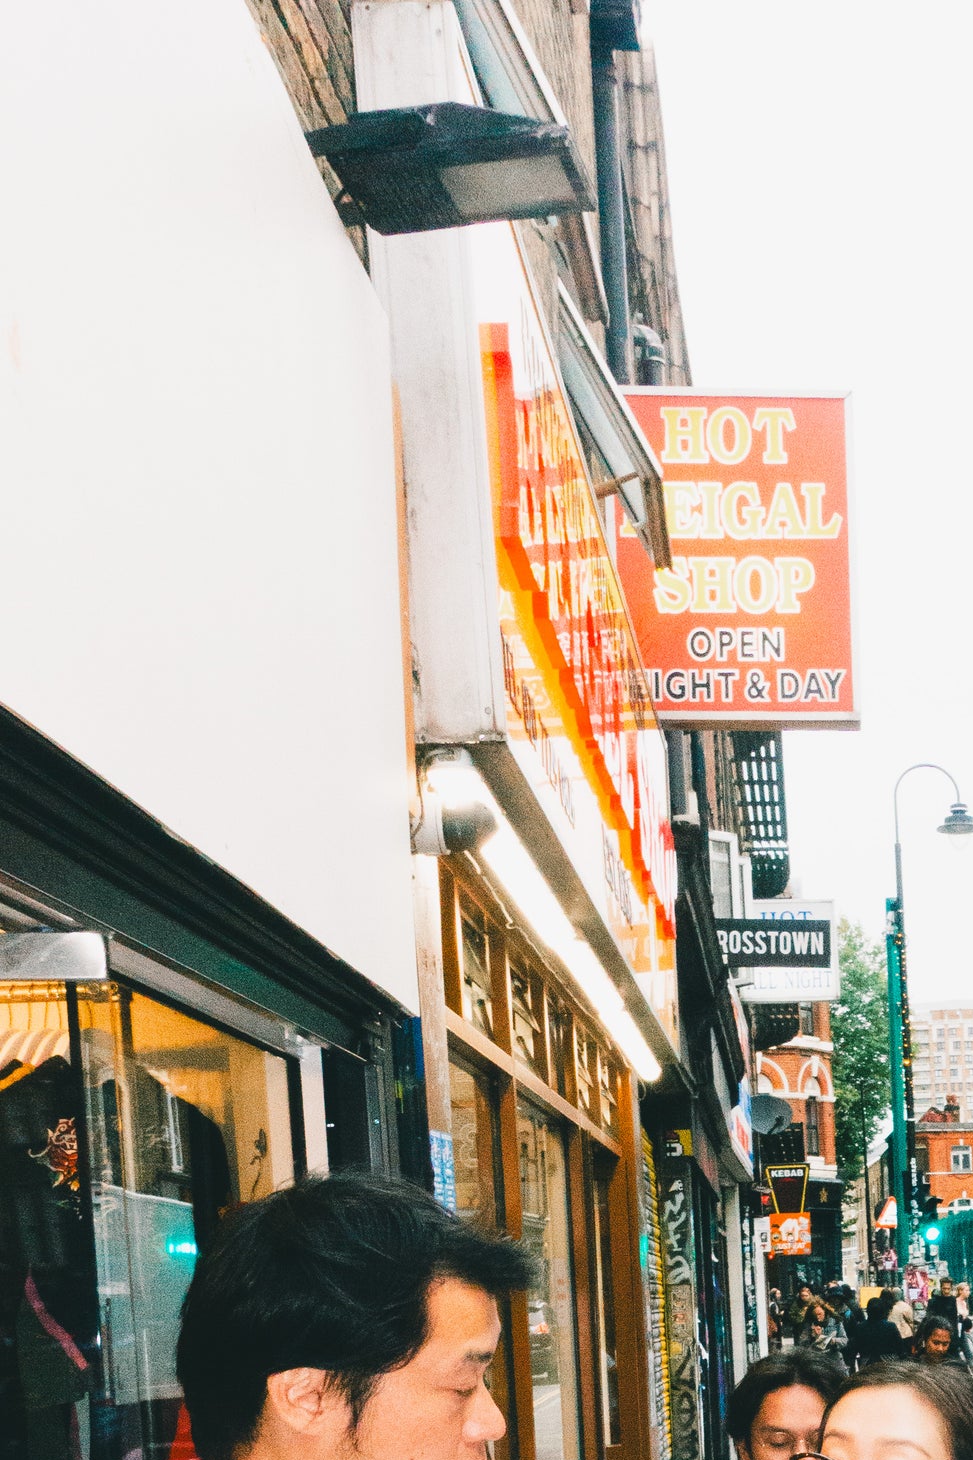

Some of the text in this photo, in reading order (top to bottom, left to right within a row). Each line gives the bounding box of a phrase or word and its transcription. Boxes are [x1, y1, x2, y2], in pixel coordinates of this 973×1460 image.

[660, 406, 797, 465] HOT
[620, 481, 843, 539] EIGAL
[652, 556, 816, 614] SHOP
[688, 628, 784, 661] OPEN
[645, 669, 846, 702] IGHT & DAY
[717, 930, 824, 955] ROSSTOWN
[785, 970, 831, 988] NIGHT
[771, 1169, 804, 1178] KEBAB
